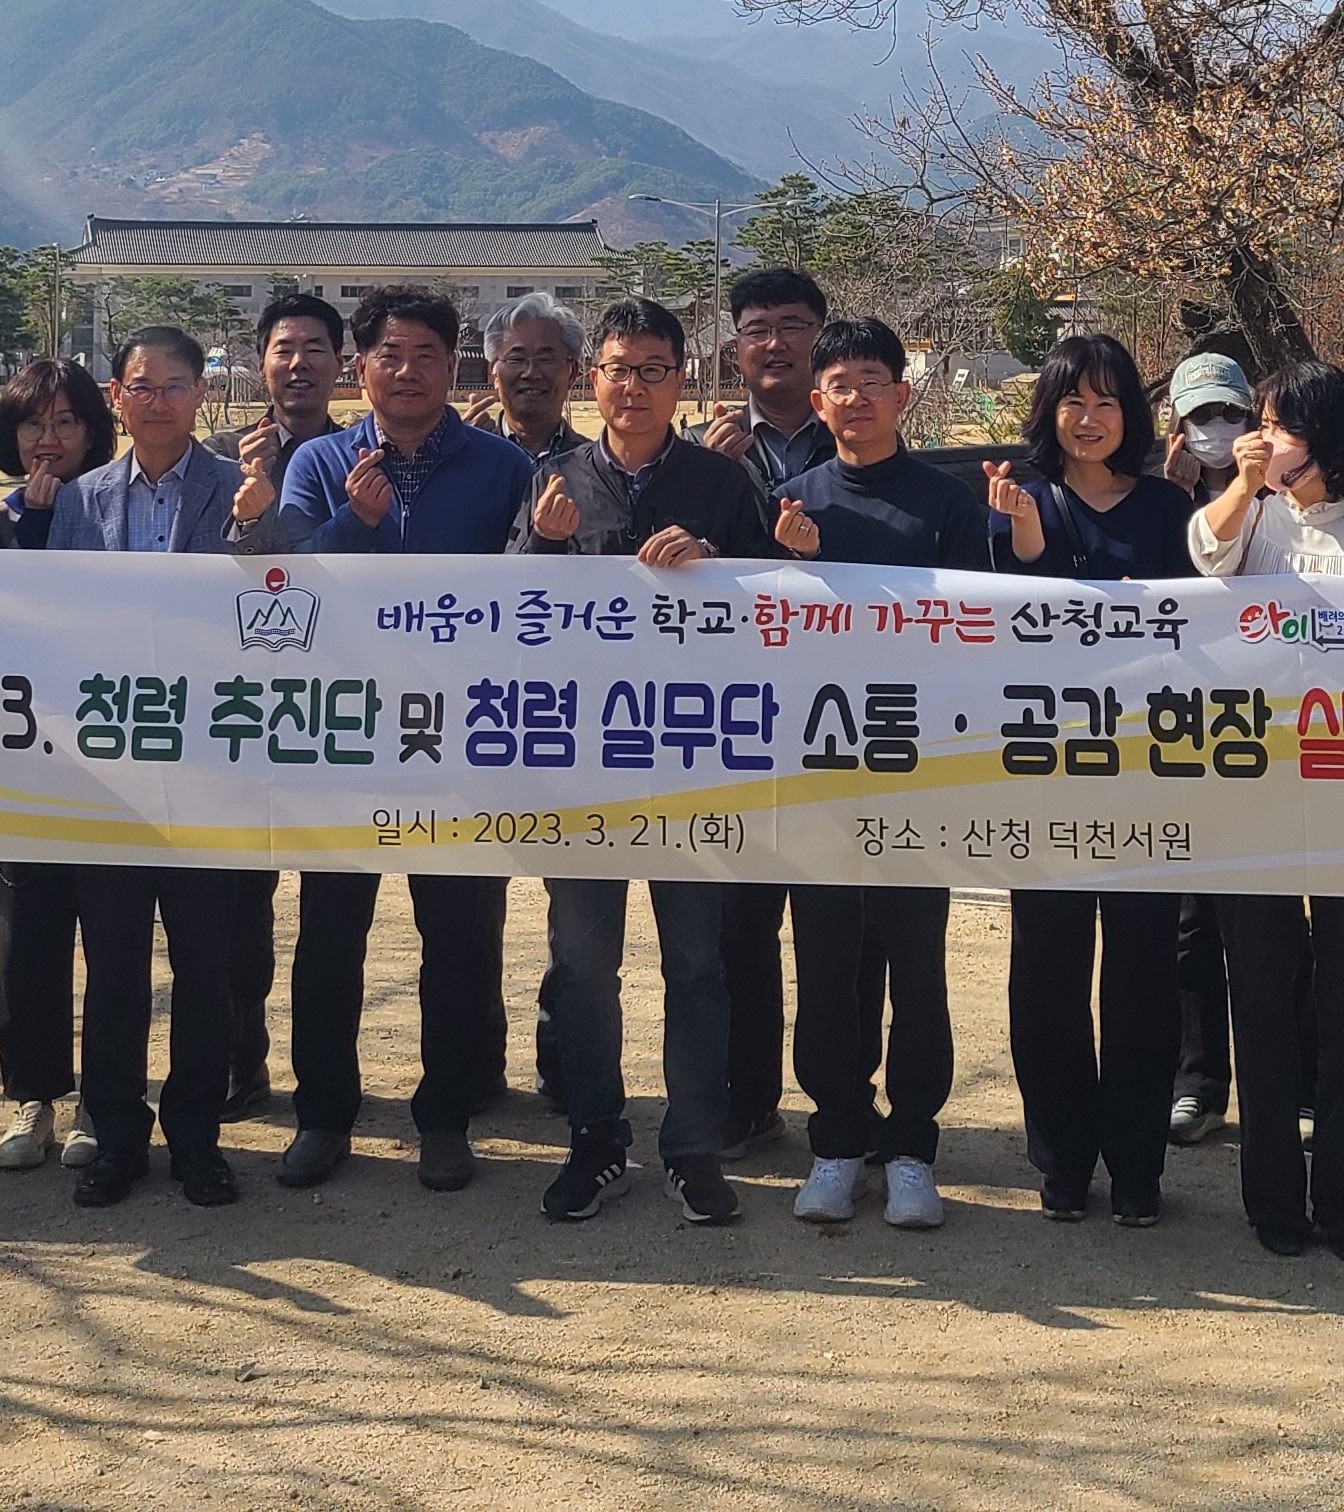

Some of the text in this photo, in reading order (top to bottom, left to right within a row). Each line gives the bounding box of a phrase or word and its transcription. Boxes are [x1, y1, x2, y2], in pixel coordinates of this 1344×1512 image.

[376, 593, 501, 645] 배움이
[515, 589, 637, 646] 즐거운
[868, 598, 996, 645] 가꾸는
[1010, 597, 1189, 651] 산청교육
[75, 672, 188, 762] 청렴
[208, 674, 383, 765] 추진단
[398, 690, 445, 765] 및
[465, 677, 579, 769] 청렴
[601, 679, 780, 772] 실무단
[802, 682, 921, 773] 소통
[1000, 685, 1122, 777] 공감
[1146, 685, 1273, 779] 현장
[372, 809, 437, 844] 일시
[473, 812, 571, 847] 2023.
[855, 817, 926, 855] 장소
[961, 818, 1032, 859] 산청
[1048, 820, 1192, 861] 덕천서원
